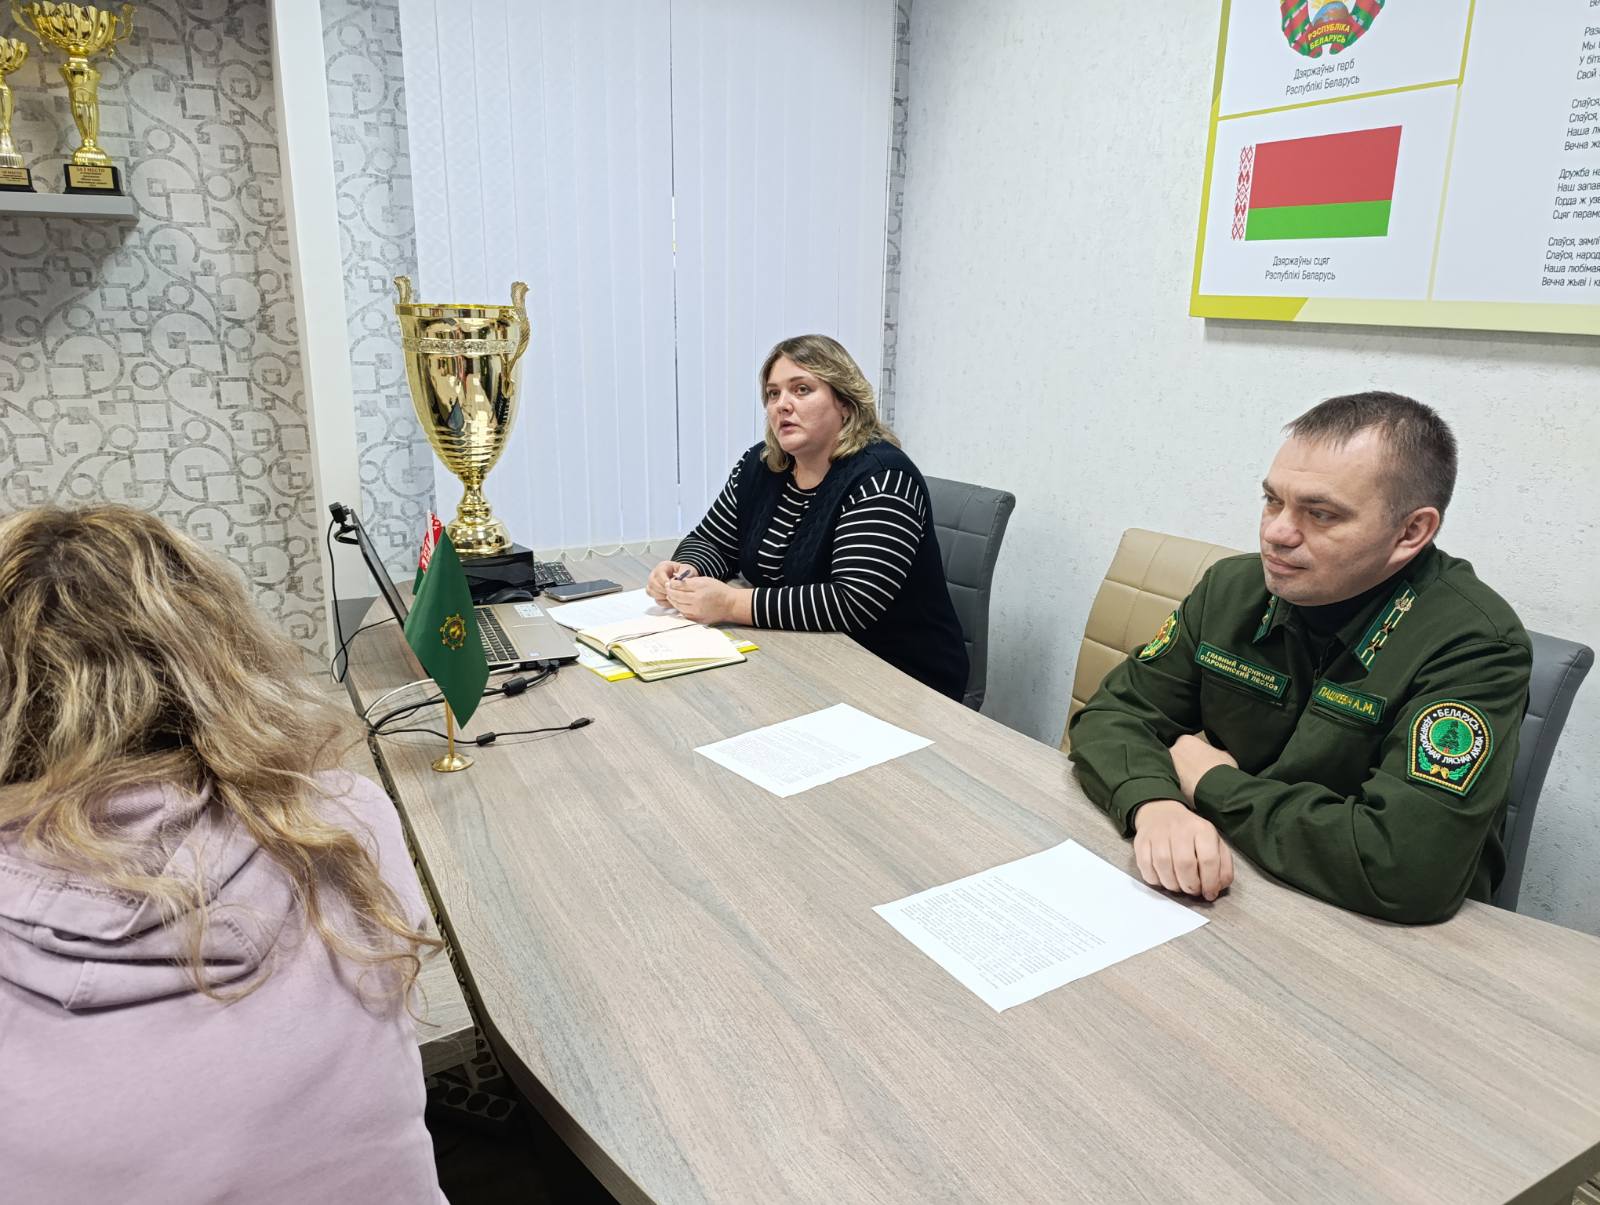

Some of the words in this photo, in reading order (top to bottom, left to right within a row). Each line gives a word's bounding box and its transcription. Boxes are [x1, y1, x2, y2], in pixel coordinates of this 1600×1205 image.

[1307, 22, 1351, 41] РЭСПУБЛІКА
[1309, 33, 1346, 50] БЕЛАРУСЬ
[1582, 41, 1595, 51] Мы
[1294, 63, 1335, 80] Дзяржаўны
[1336, 58, 1355, 73] герб
[1576, 68, 1597, 80] Свой
[1285, 79, 1323, 96] Рэспублікі
[1324, 75, 1360, 90] Беларусь
[1566, 127, 1590, 137] Наша
[1564, 141, 1589, 151] Вечна
[1558, 167, 1590, 180] Дружба
[1557, 183, 1576, 192] Наш
[1555, 196, 1577, 207] Горда
[1579, 197, 1587, 205] ж
[1552, 209, 1571, 220] Сцяг
[1272, 256, 1312, 268] Дзяржаўны
[1314, 257, 1331, 266] сцяг
[1543, 264, 1566, 273] Наша
[1265, 270, 1300, 282] Рэспублікі
[1301, 270, 1336, 282] Беларусь
[1541, 276, 1565, 287] Вечна
[1566, 277, 1587, 287] жыві
[1206, 651, 1237, 667] ГЛАВНЫЙ
[1239, 664, 1276, 682] ЛЕСНИЧИЙ
[1250, 675, 1279, 691] ЛЕСХОЗ
[1437, 708, 1480, 731] БЕЛАРУСЬ
[1442, 754, 1472, 765] ЛЯСНАЯ
[1471, 736, 1484, 759] АХОВА
